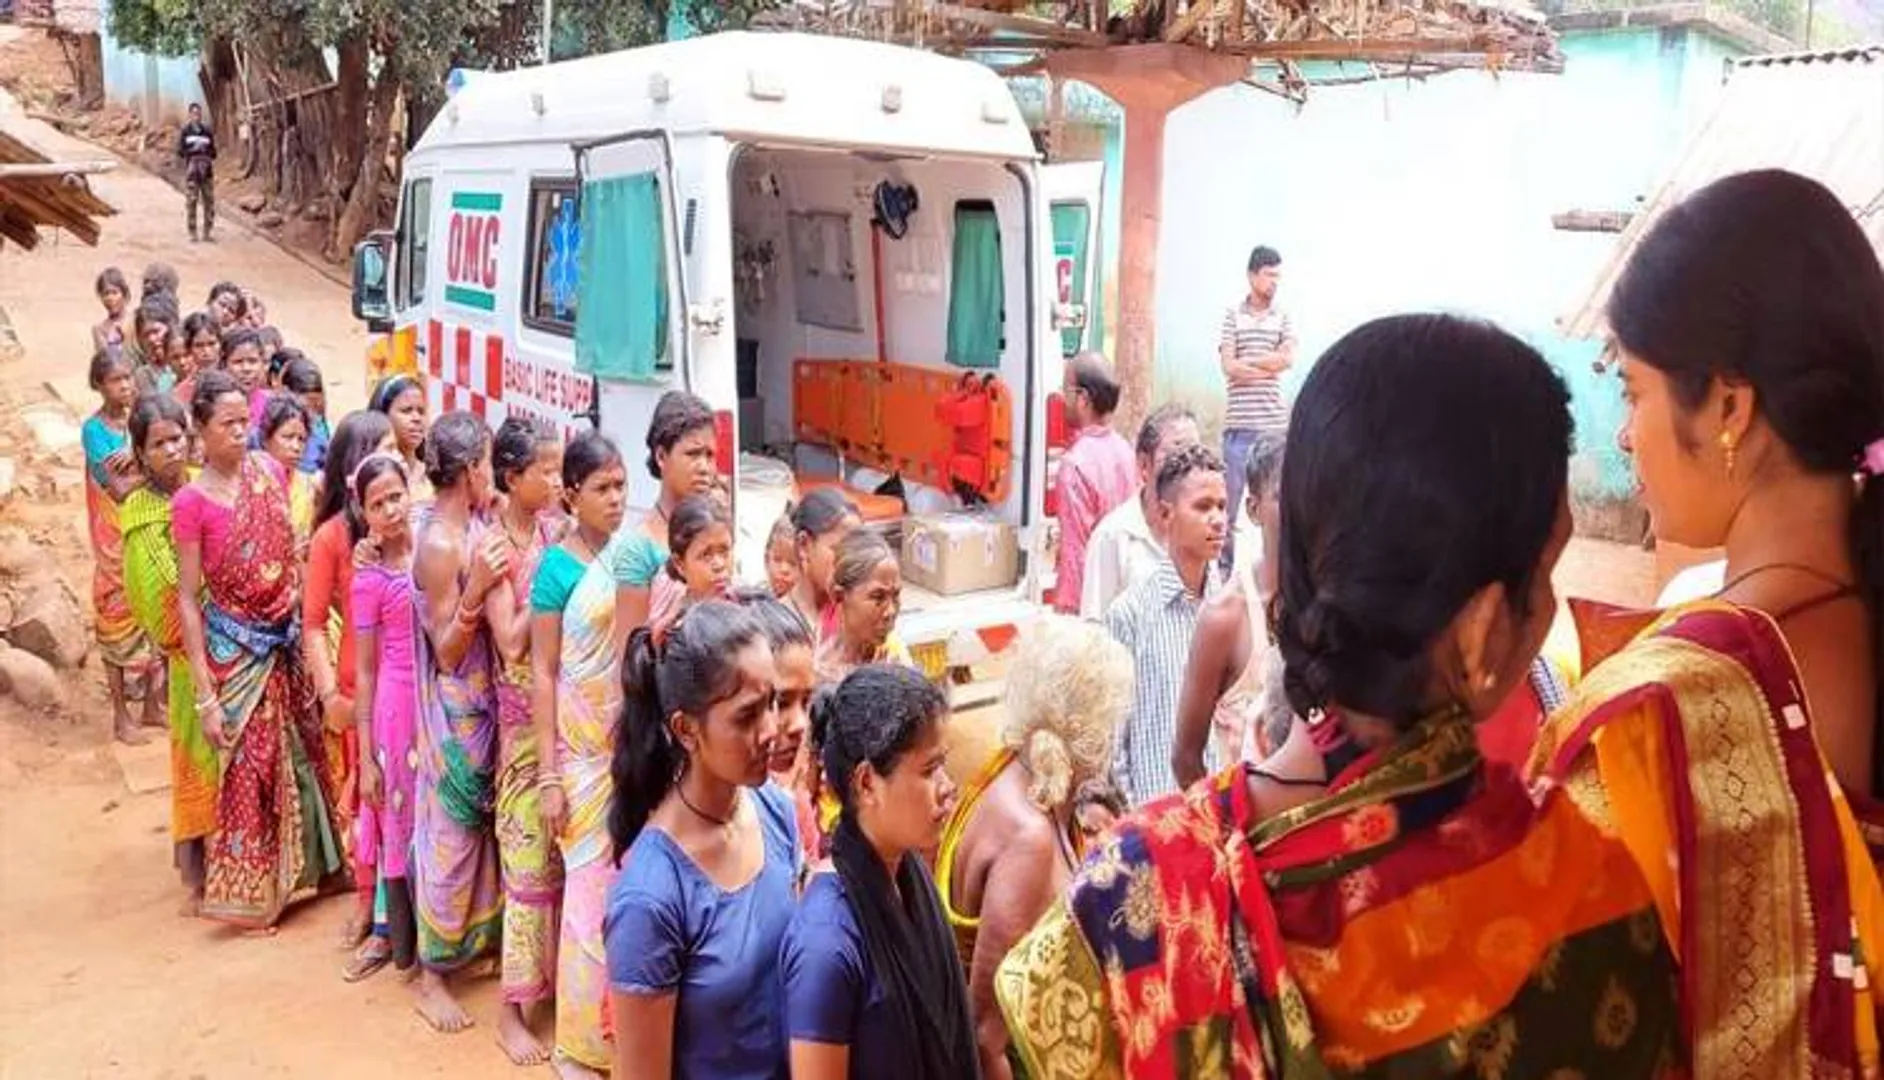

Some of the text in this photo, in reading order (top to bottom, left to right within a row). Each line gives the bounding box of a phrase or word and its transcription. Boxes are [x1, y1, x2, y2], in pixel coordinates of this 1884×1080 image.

[447, 212, 500, 289] OMC
[504, 357, 591, 414] BASIC LIFE SUPP
